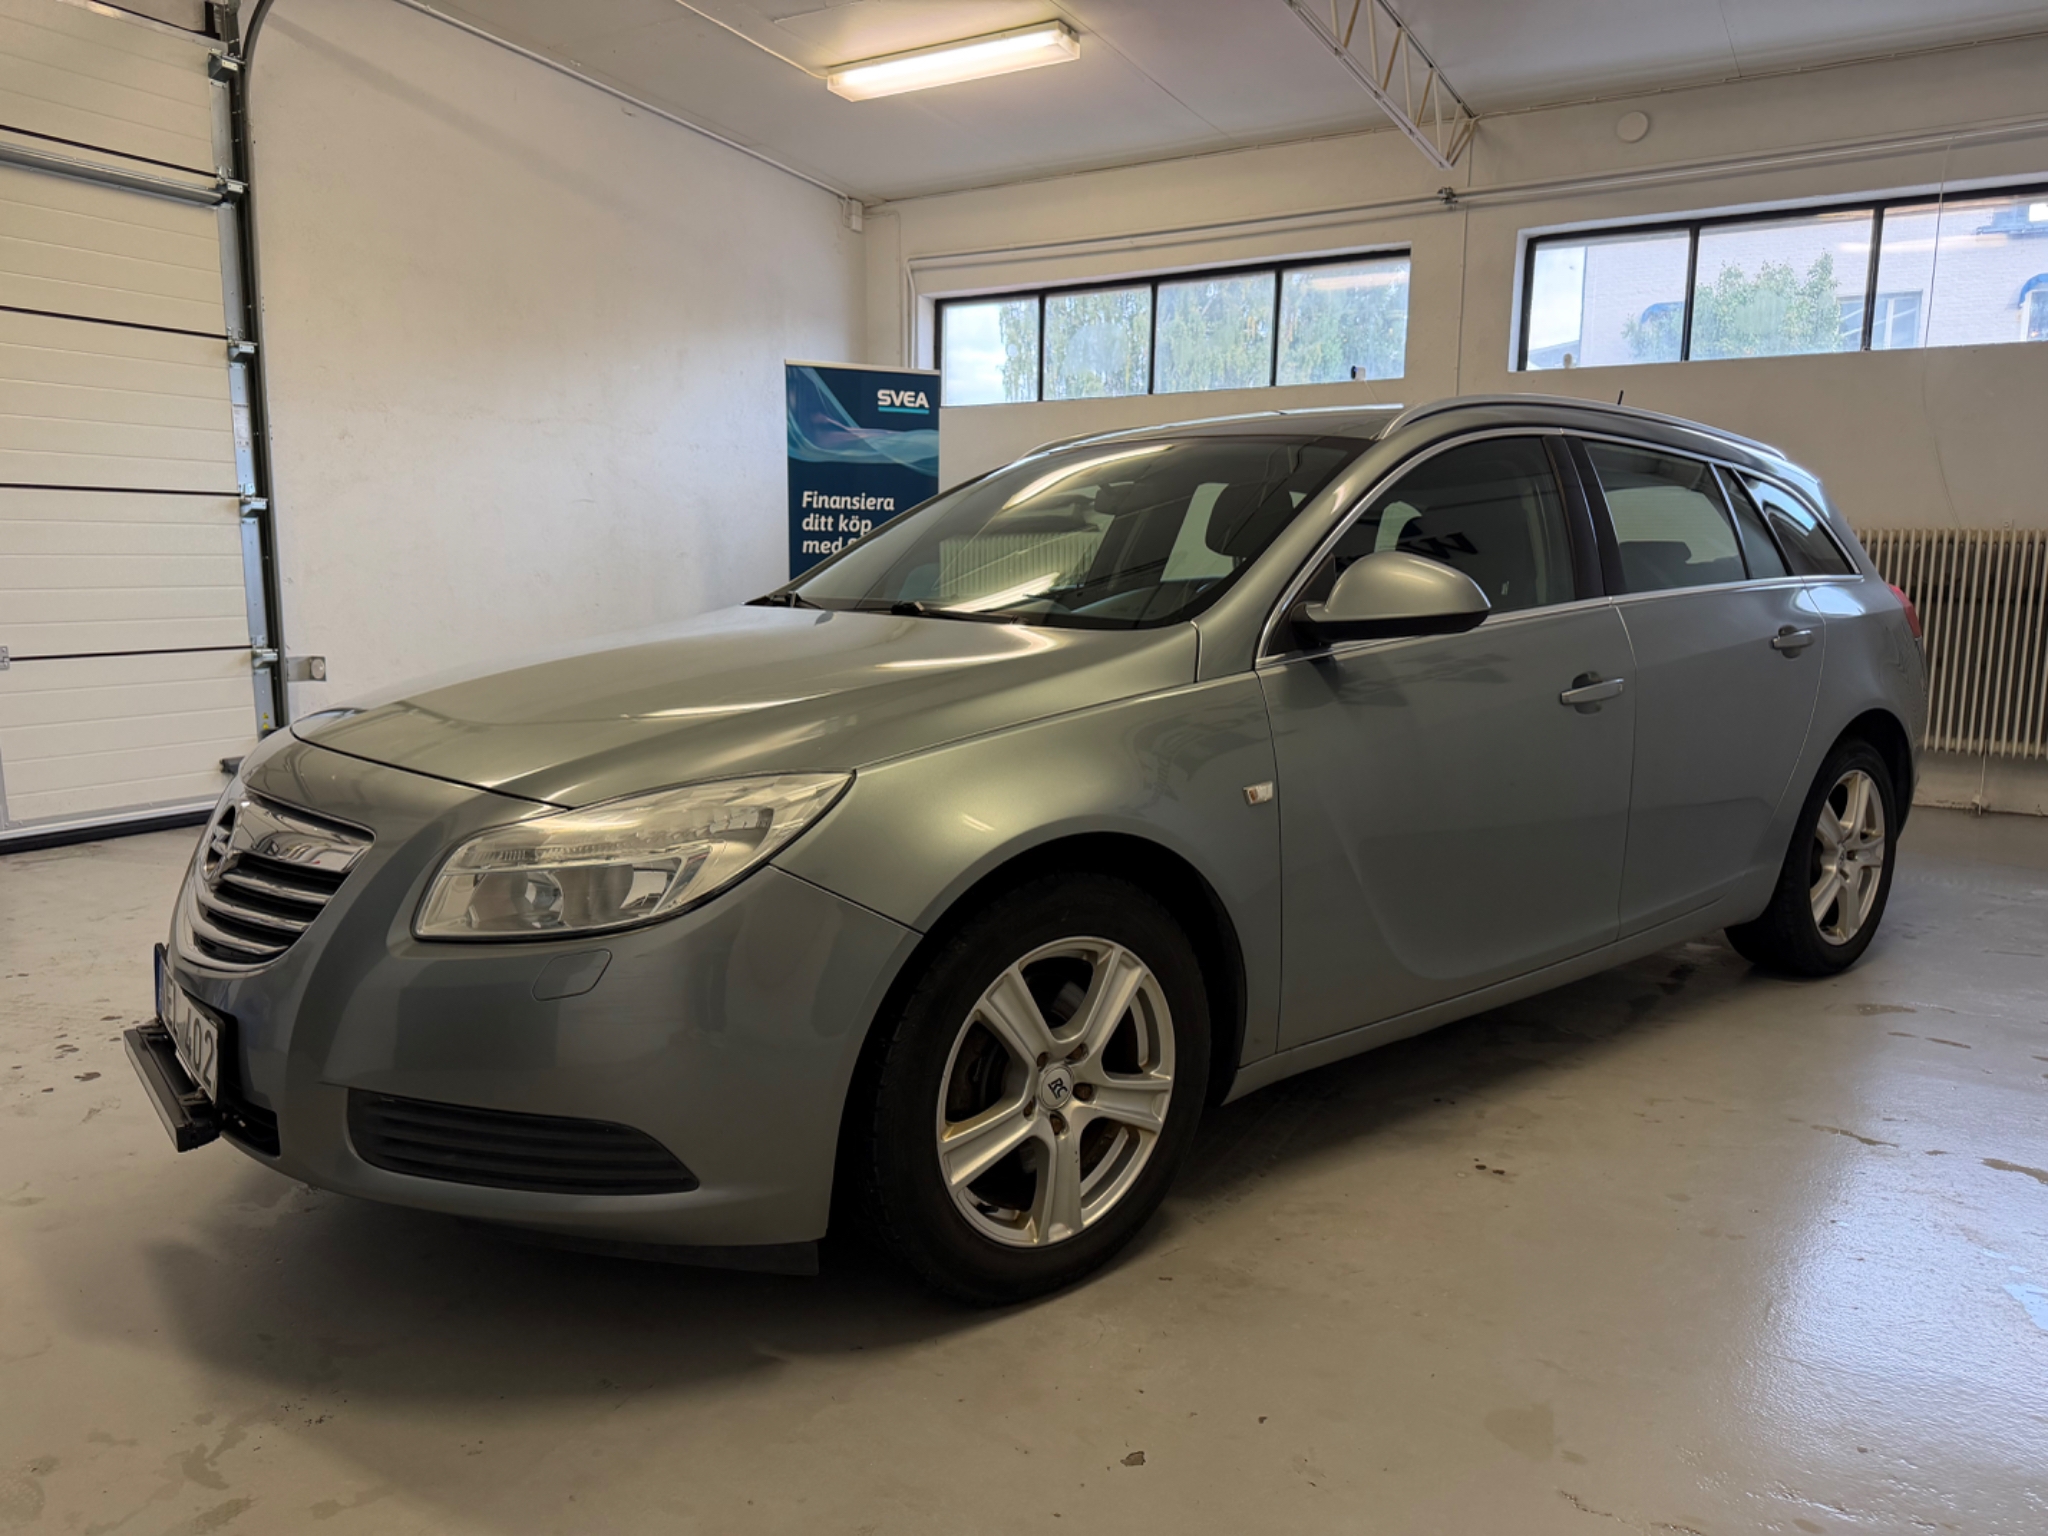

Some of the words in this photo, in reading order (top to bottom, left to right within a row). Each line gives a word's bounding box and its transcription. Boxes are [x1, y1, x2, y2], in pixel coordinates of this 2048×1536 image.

[877, 389, 930, 408] SVEA
[802, 490, 895, 511] Finansiera
[802, 512, 834, 532] ditt
[838, 513, 872, 536] köp
[802, 536, 843, 554] med
[185, 1007, 215, 1091] 402
